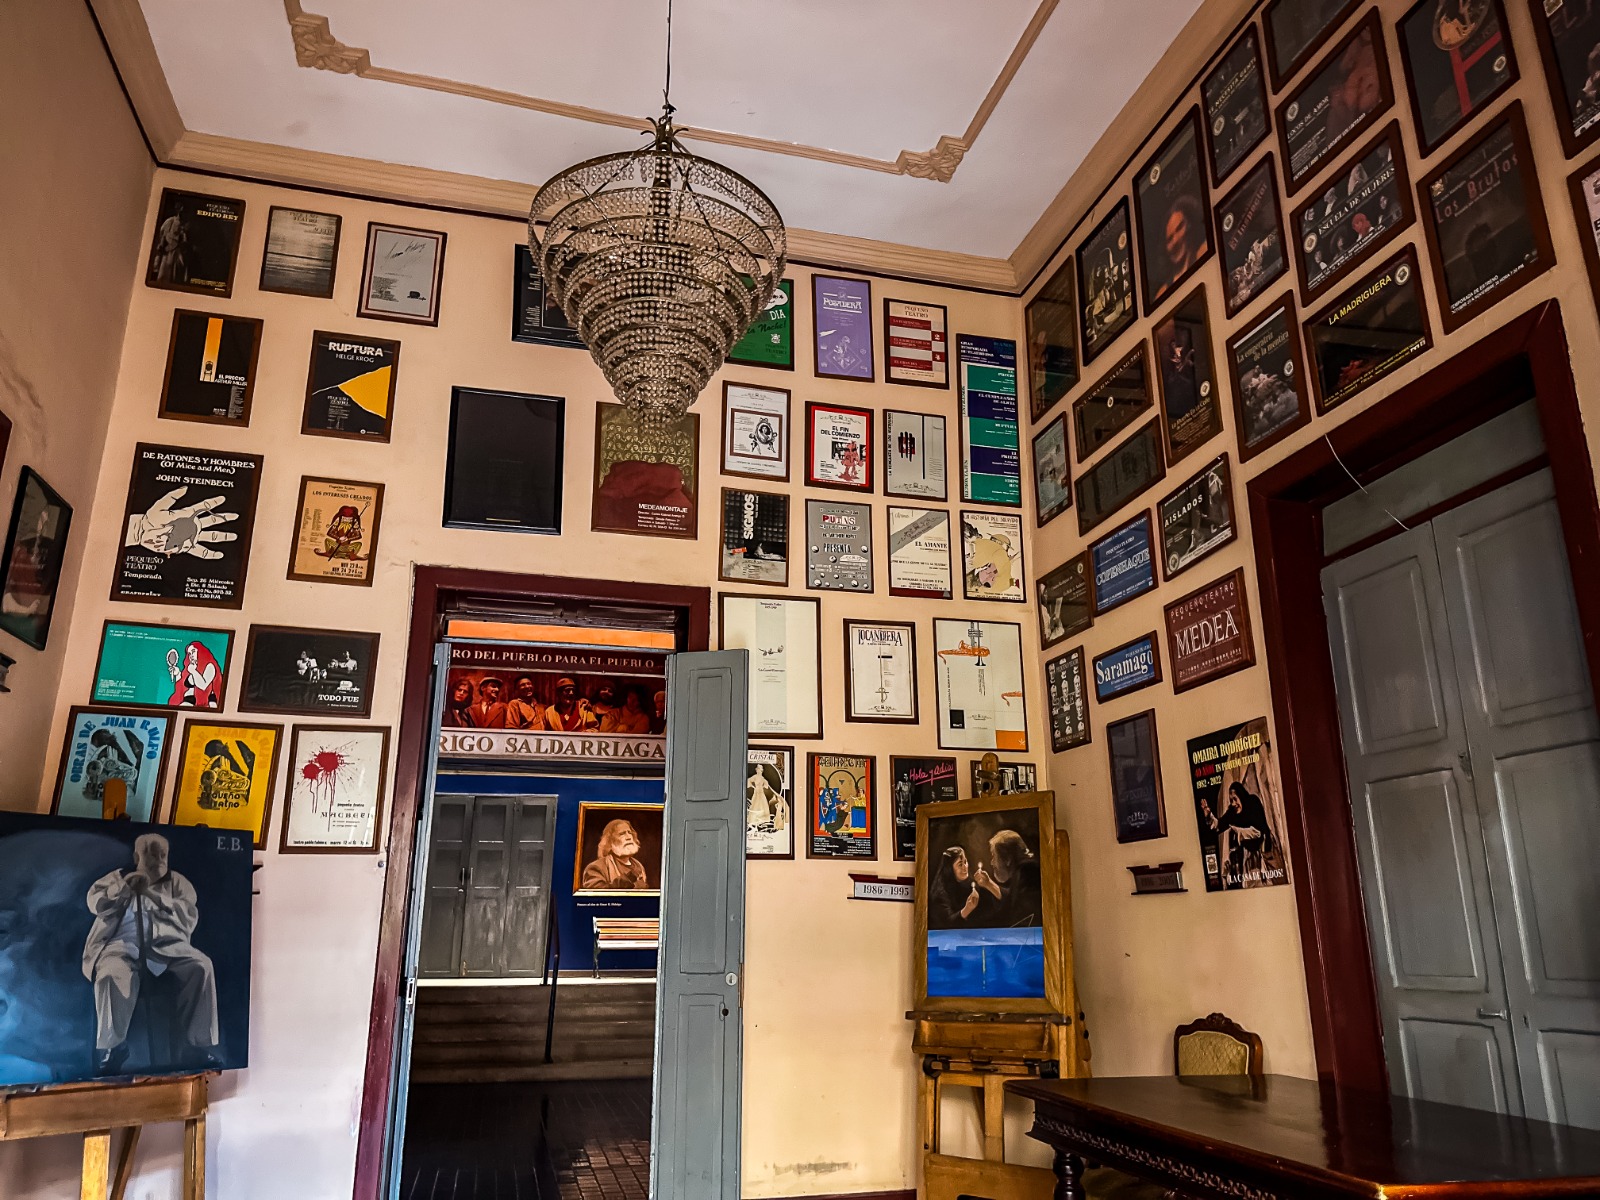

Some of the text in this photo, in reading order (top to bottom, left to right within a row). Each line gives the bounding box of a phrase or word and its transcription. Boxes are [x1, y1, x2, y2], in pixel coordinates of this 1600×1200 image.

[1215, 79, 1239, 106] NECESITA
[1435, 154, 1518, 224] Las Brutas
[1318, 167, 1395, 235] ESCUELA DE MUJERES
[197, 210, 239, 221] EDIPO REY
[1238, 182, 1268, 237] Inspector
[1328, 274, 1392, 326] LA MADRIGUERA
[770, 309, 786, 321] DIA
[758, 320, 787, 333] Noche!
[329, 342, 384, 357] RUPTURA
[1253, 331, 1290, 362] de la mentira
[356, 355, 375, 363] KROG
[1236, 354, 1245, 364] La
[832, 431, 861, 439] COMIENZO
[157, 453, 201, 464] RATONES
[210, 458, 256, 469] HOMBRES
[160, 460, 175, 469] (Of
[176, 462, 196, 470] Mice
[213, 466, 236, 475] Men)
[156, 474, 235, 488] JOHN STEINBECK
[638, 503, 688, 514] MEDEAMONTAJE
[1165, 494, 1203, 528] AISLADOS
[744, 494, 755, 540] SIGNOS
[824, 543, 852, 554] PRESENTA
[125, 562, 157, 571] TEATRO
[126, 555, 164, 567] PEQUEÑO
[1096, 547, 1151, 586] COPENHAGUE
[124, 571, 163, 580] Temporada
[1171, 582, 1234, 618] PEQUEÑO TEATRO
[1174, 609, 1240, 659] MEDEA
[474, 650, 500, 660] DEL
[502, 652, 552, 663] PUEBLO
[555, 655, 586, 665] PARA
[590, 657, 605, 665] EL
[607, 658, 654, 668] PUEBLO
[1096, 650, 1154, 685] Saramago
[318, 694, 360, 703] TODO FUE
[70, 717, 161, 783] OBRAS DE JUAN RULFO
[505, 736, 665, 759] SALDARRIAGA
[1192, 733, 1262, 765] OMAIRA RODRÍGUEZ
[1215, 763, 1222, 773] EN
[1221, 758, 1242, 771] PEQUEÑO
[1242, 753, 1260, 766] TEATRO
[909, 767, 929, 781] Hola
[929, 770, 933, 786] y
[1196, 775, 1222, 790] 1982 2022
[217, 836, 244, 852] E.B.
[1237, 873, 1253, 883] CASA
[1252, 871, 1260, 880] DE
[1262, 869, 1284, 879] TODOS!
[863, 885, 883, 894] 1986
[890, 886, 909, 896] 1995
